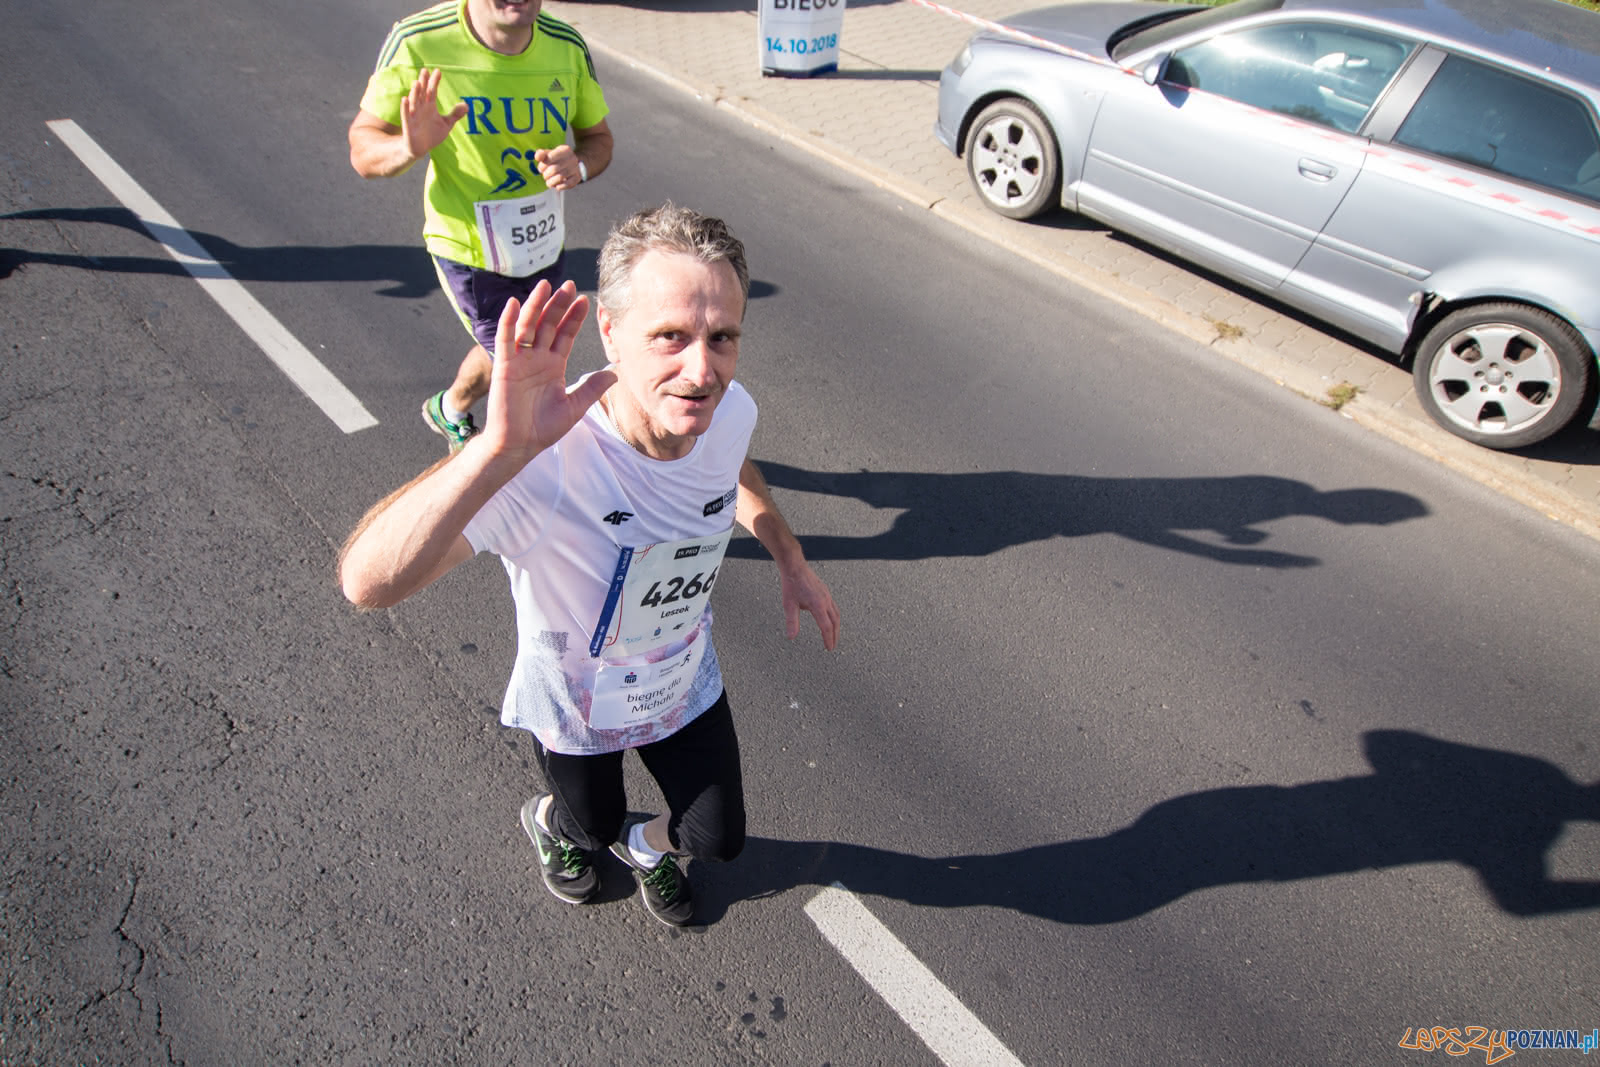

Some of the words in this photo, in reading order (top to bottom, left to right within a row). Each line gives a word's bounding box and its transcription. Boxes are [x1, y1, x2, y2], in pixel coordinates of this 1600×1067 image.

[766, 33, 837, 54] 14.10.2018
[460, 95, 570, 134] RUN
[511, 213, 556, 245] 5822
[603, 510, 634, 525] 4F
[640, 565, 719, 608] 4266
[661, 605, 690, 619] Leszek
[627, 687, 666, 703] biegnę
[667, 676, 682, 691] dla
